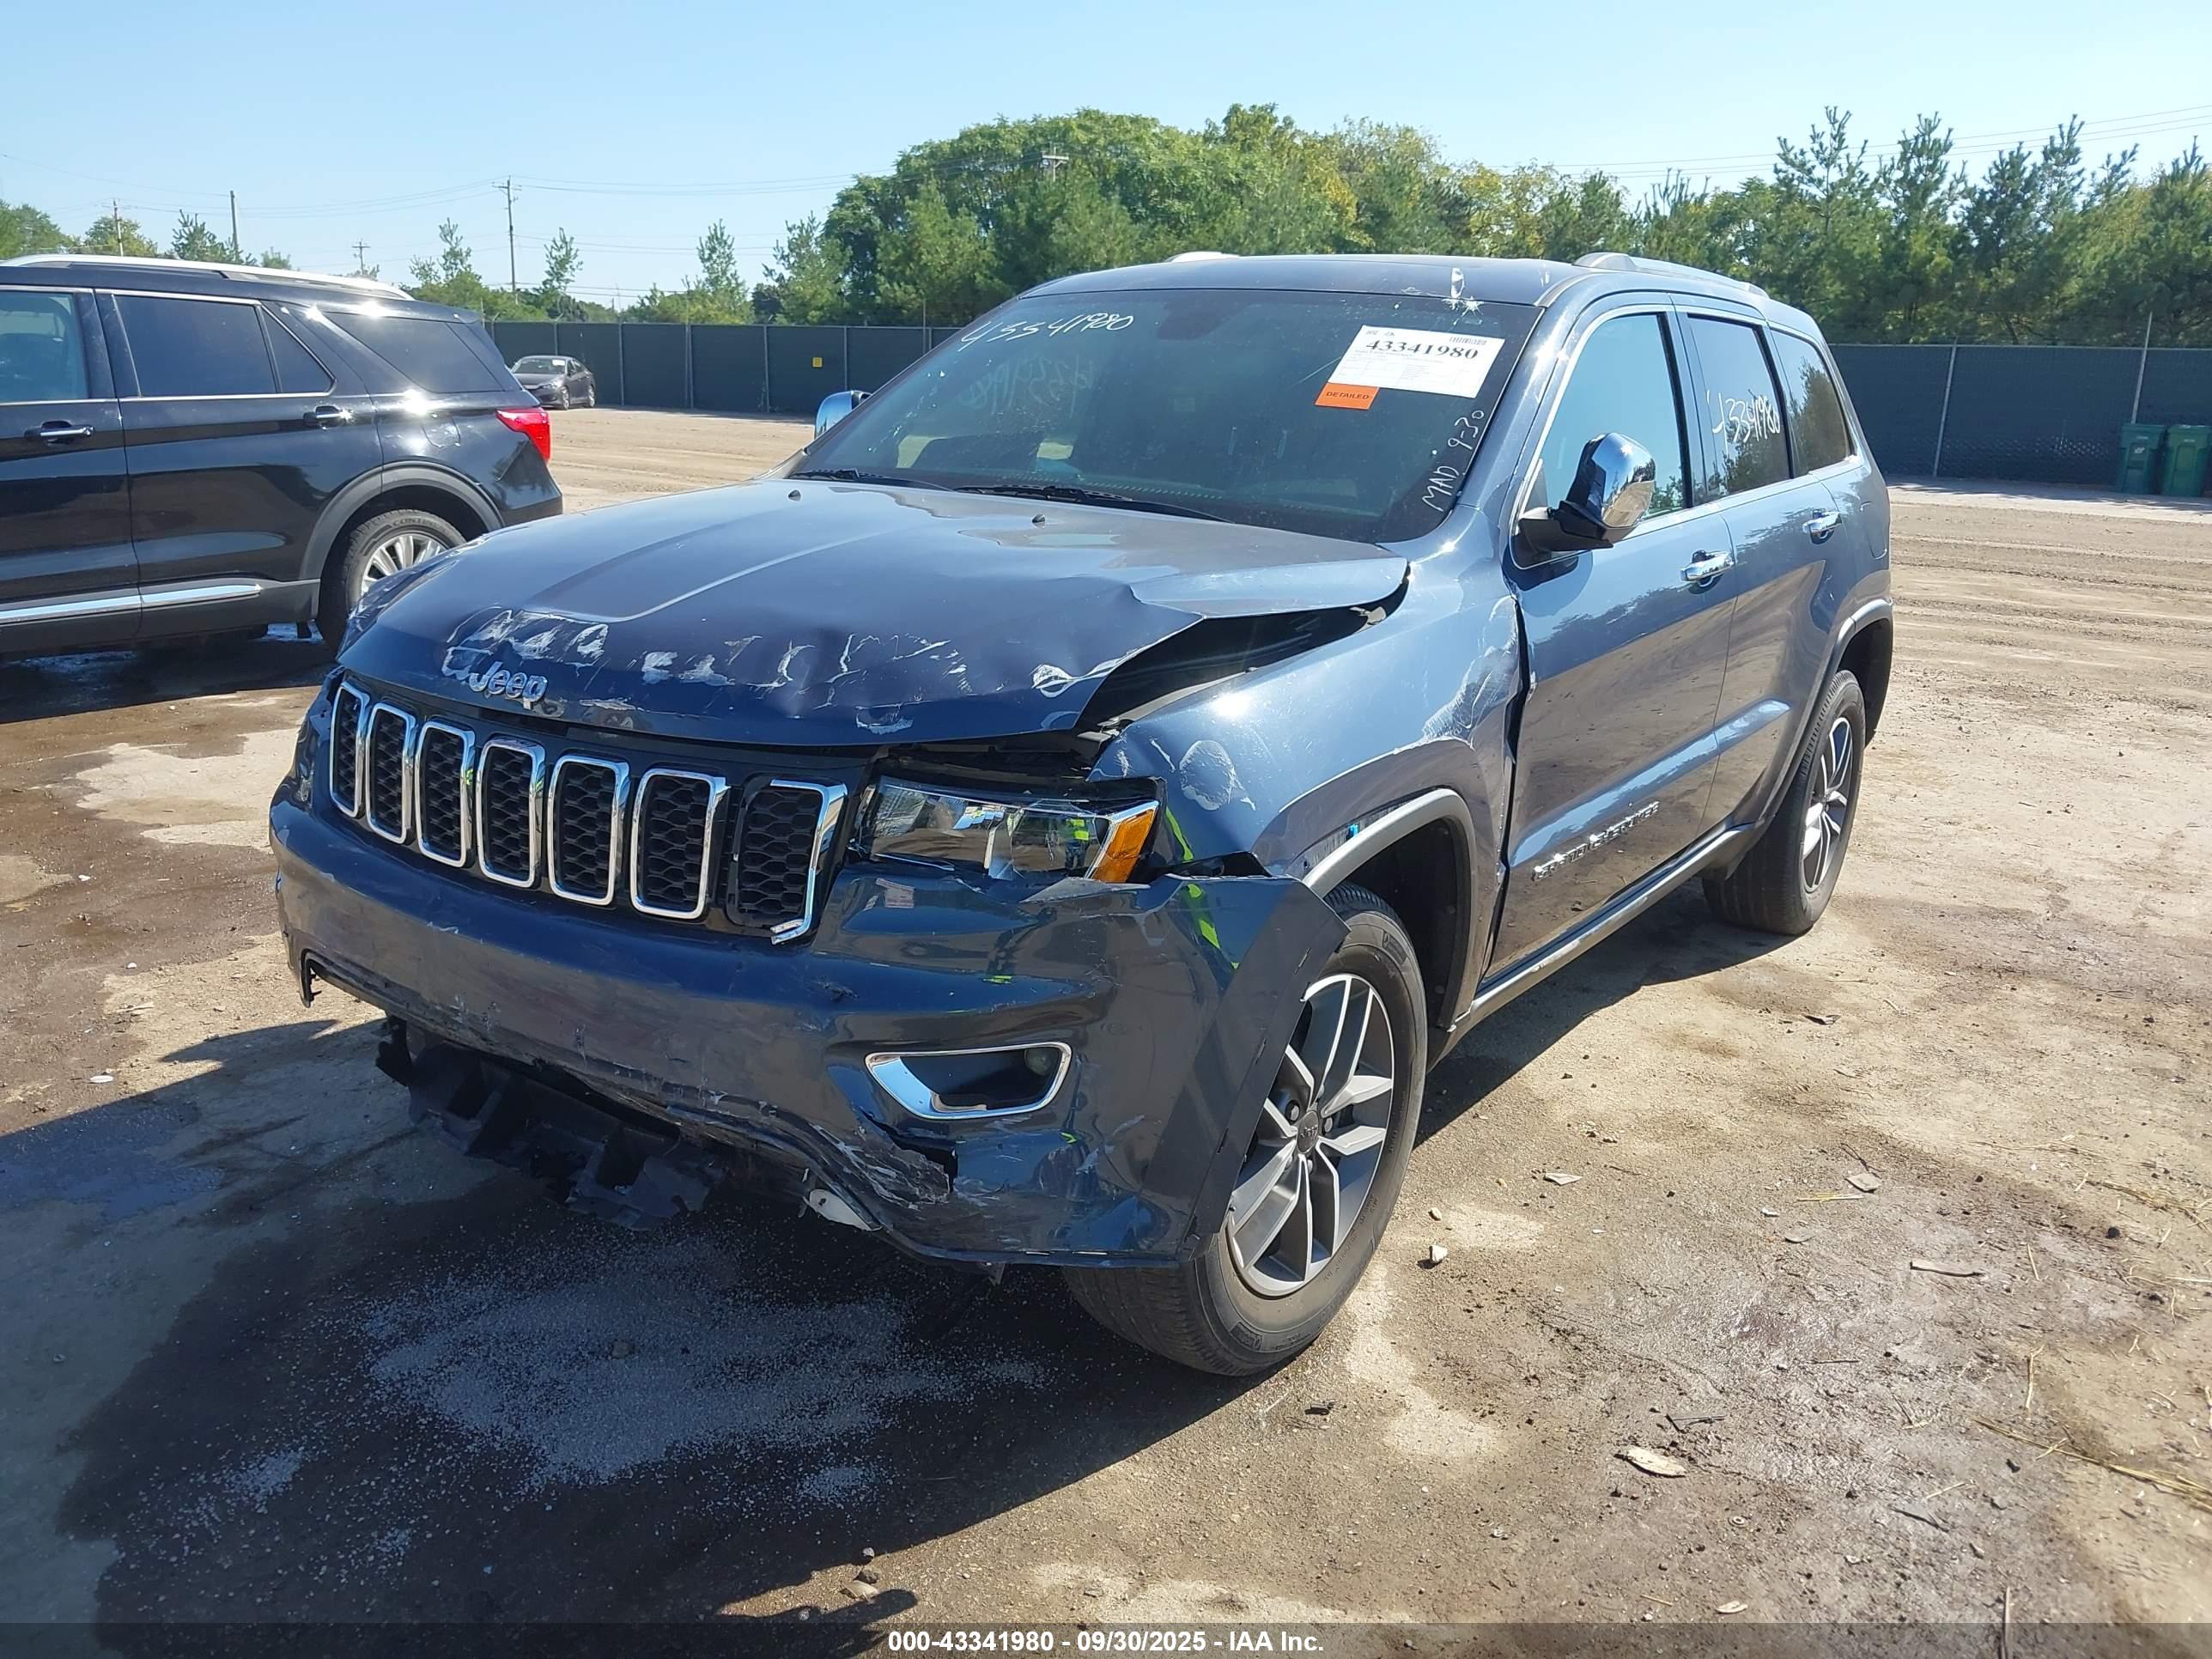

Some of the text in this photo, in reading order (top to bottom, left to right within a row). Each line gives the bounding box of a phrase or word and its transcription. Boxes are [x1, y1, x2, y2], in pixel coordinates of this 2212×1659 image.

[1365, 339, 1479, 360] 43341980
[1326, 390, 1370, 400] DETAILED
[1422, 465, 1460, 513] MAD
[469, 660, 548, 711] Jeep
